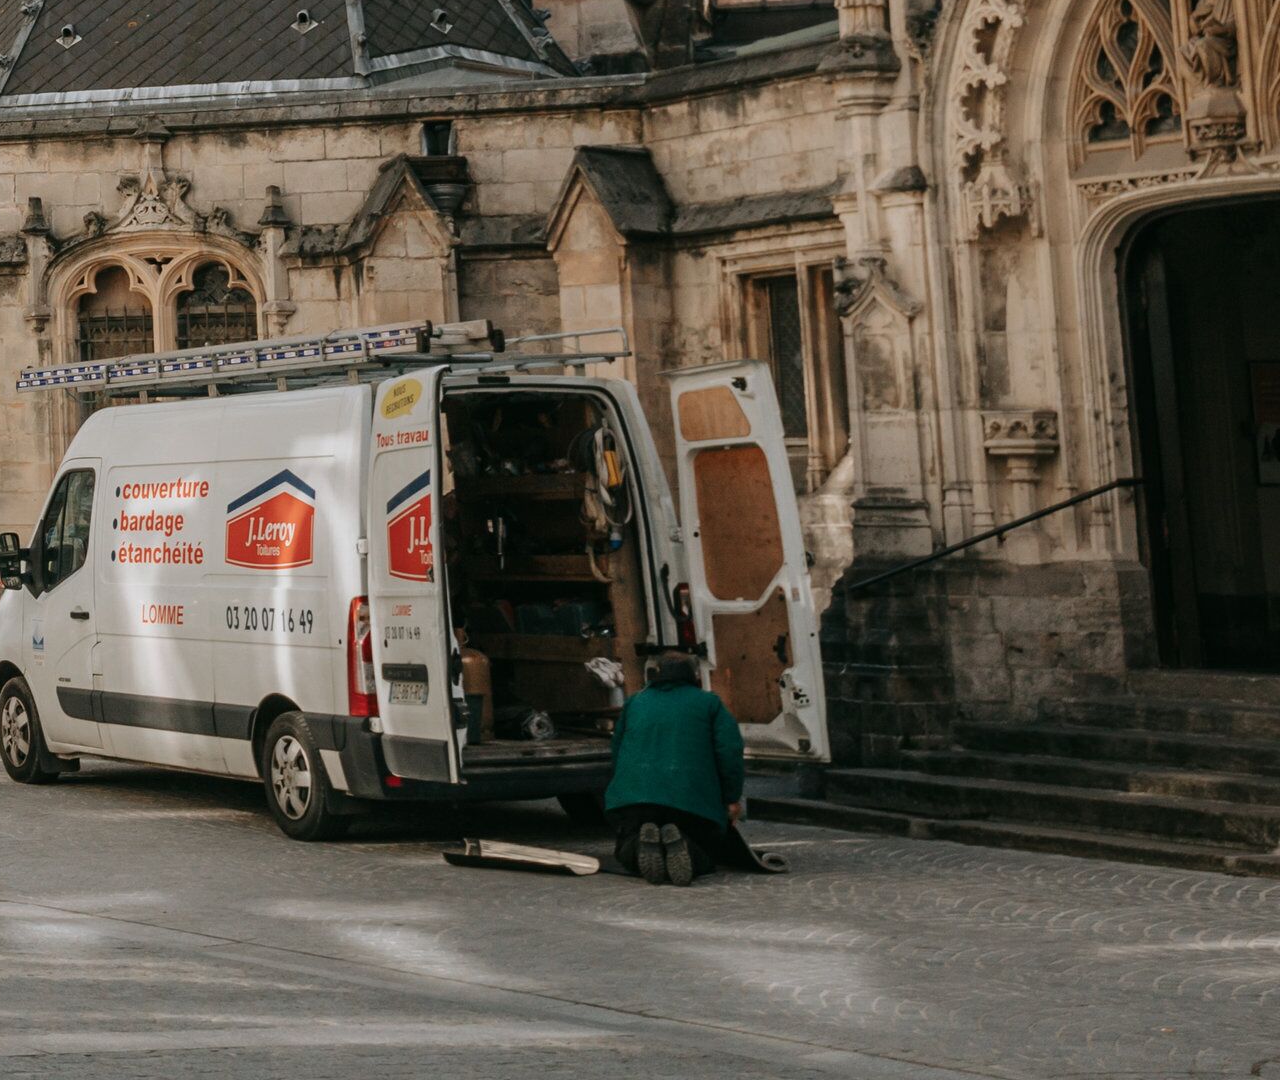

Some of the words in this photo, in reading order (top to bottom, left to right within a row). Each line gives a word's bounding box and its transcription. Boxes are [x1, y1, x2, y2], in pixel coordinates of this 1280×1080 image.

[393, 383, 406, 398] NOUS
[376, 433, 395, 448] Tous
[122, 477, 209, 499] couverture
[120, 510, 184, 537] bardage
[245, 517, 296, 547] J.Leroy
[118, 541, 204, 565] étanchéité
[256, 544, 281, 556] Toitures
[142, 604, 184, 625] LOMME
[226, 606, 240, 629] 03
[244, 606, 258, 631] 20
[261, 608, 275, 632] 07
[281, 609, 295, 633] 16
[299, 610, 314, 634] 49
